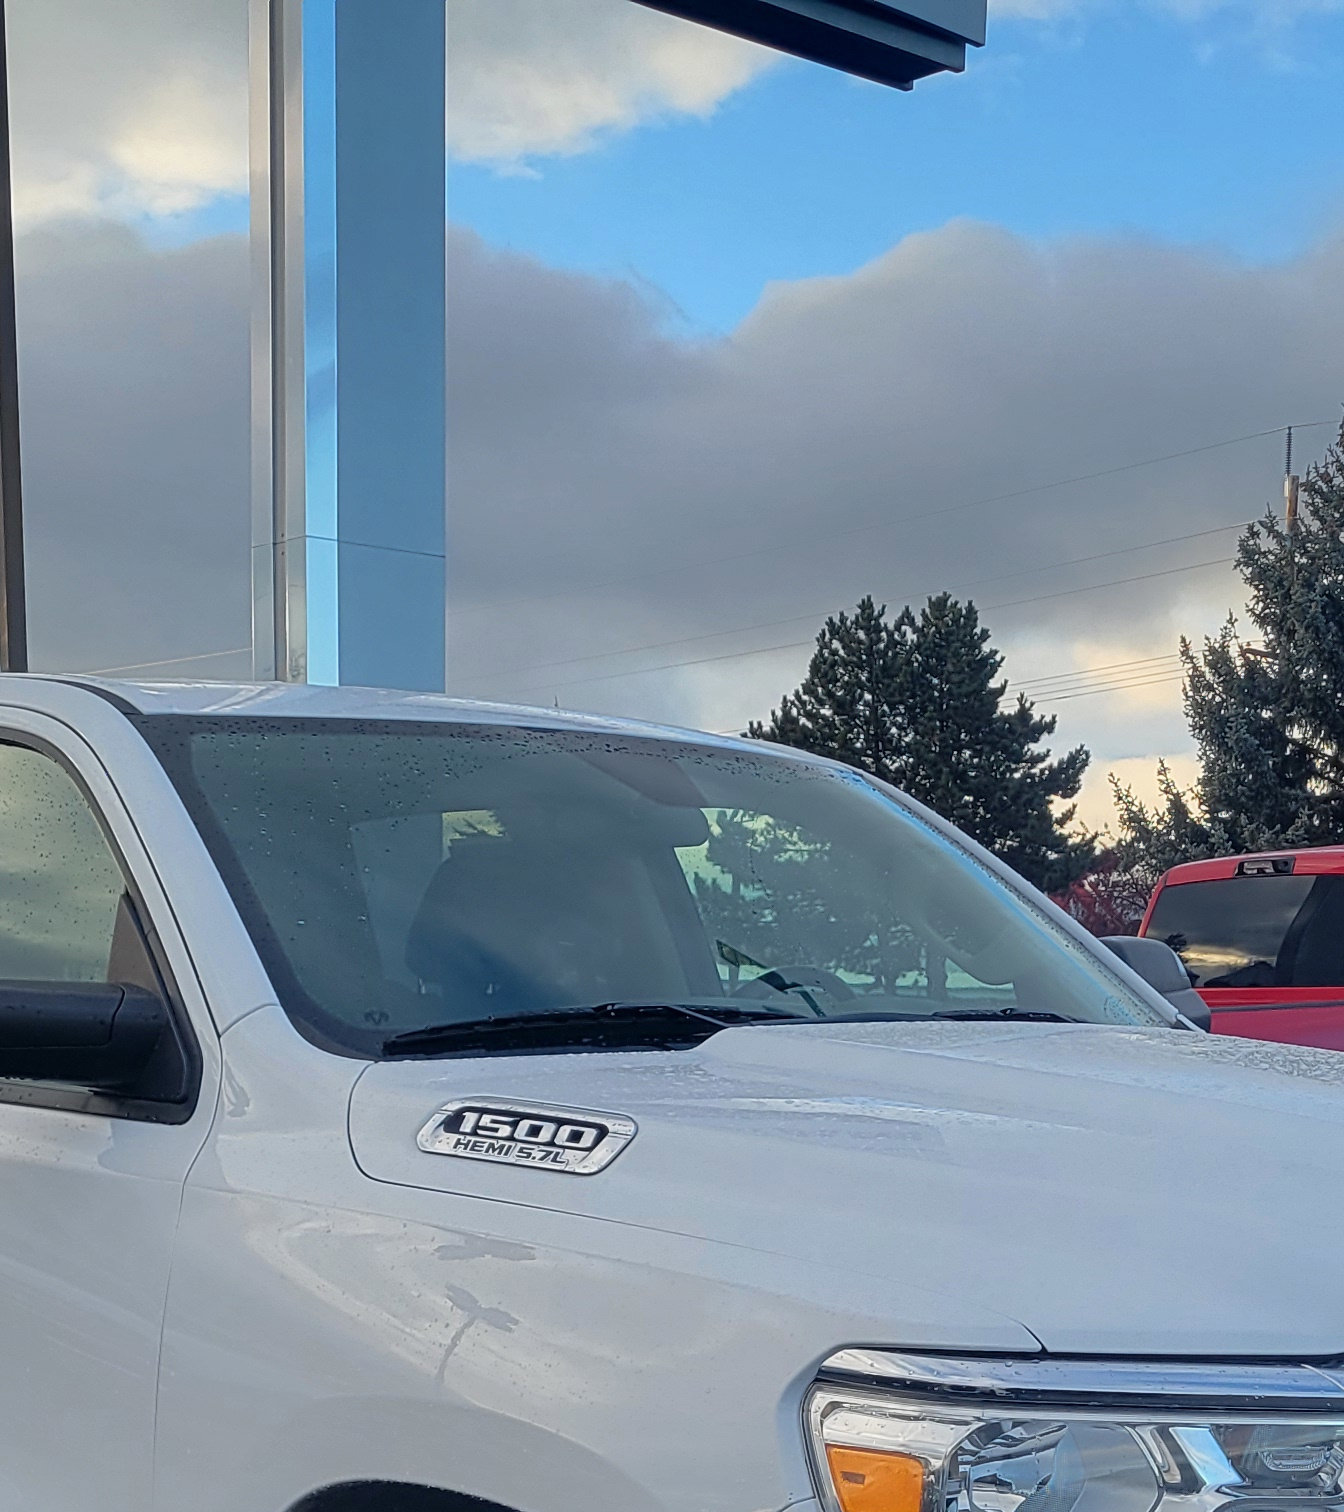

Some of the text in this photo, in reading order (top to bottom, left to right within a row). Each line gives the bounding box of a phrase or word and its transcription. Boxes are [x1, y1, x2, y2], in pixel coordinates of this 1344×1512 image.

[458, 1110, 601, 1149] 1500
[453, 1137, 570, 1167] HEMI 5.7L
